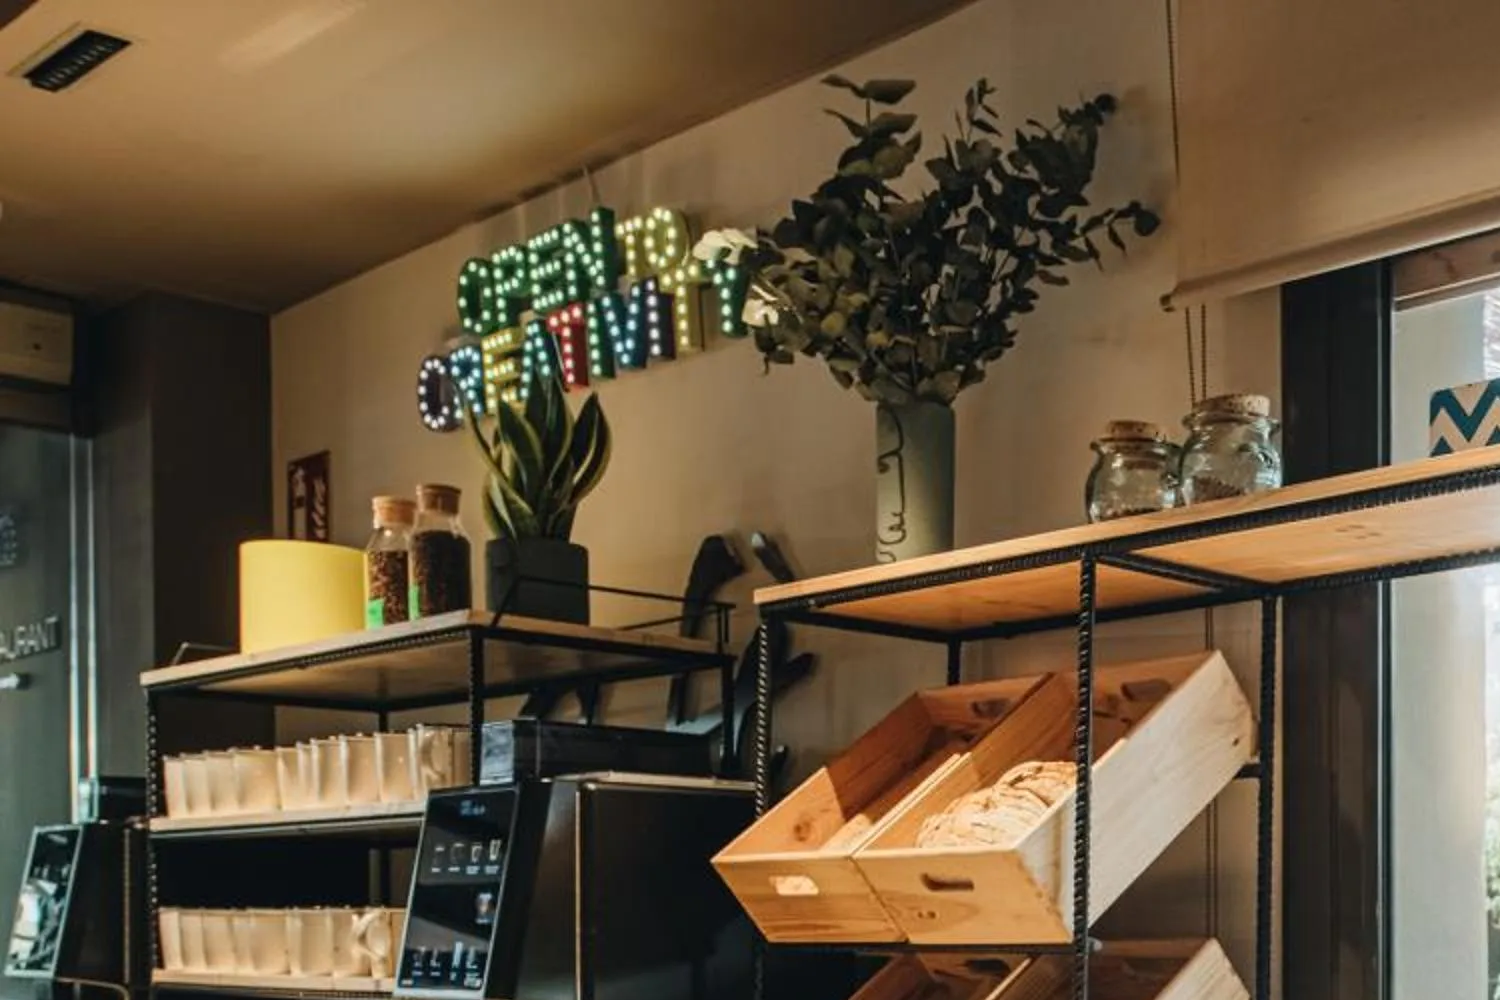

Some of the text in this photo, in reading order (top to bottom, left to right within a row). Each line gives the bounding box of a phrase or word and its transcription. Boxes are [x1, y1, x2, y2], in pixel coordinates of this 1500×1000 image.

[417, 256, 749, 433] CREATIVITY
[457, 206, 688, 335] OPEN TO
